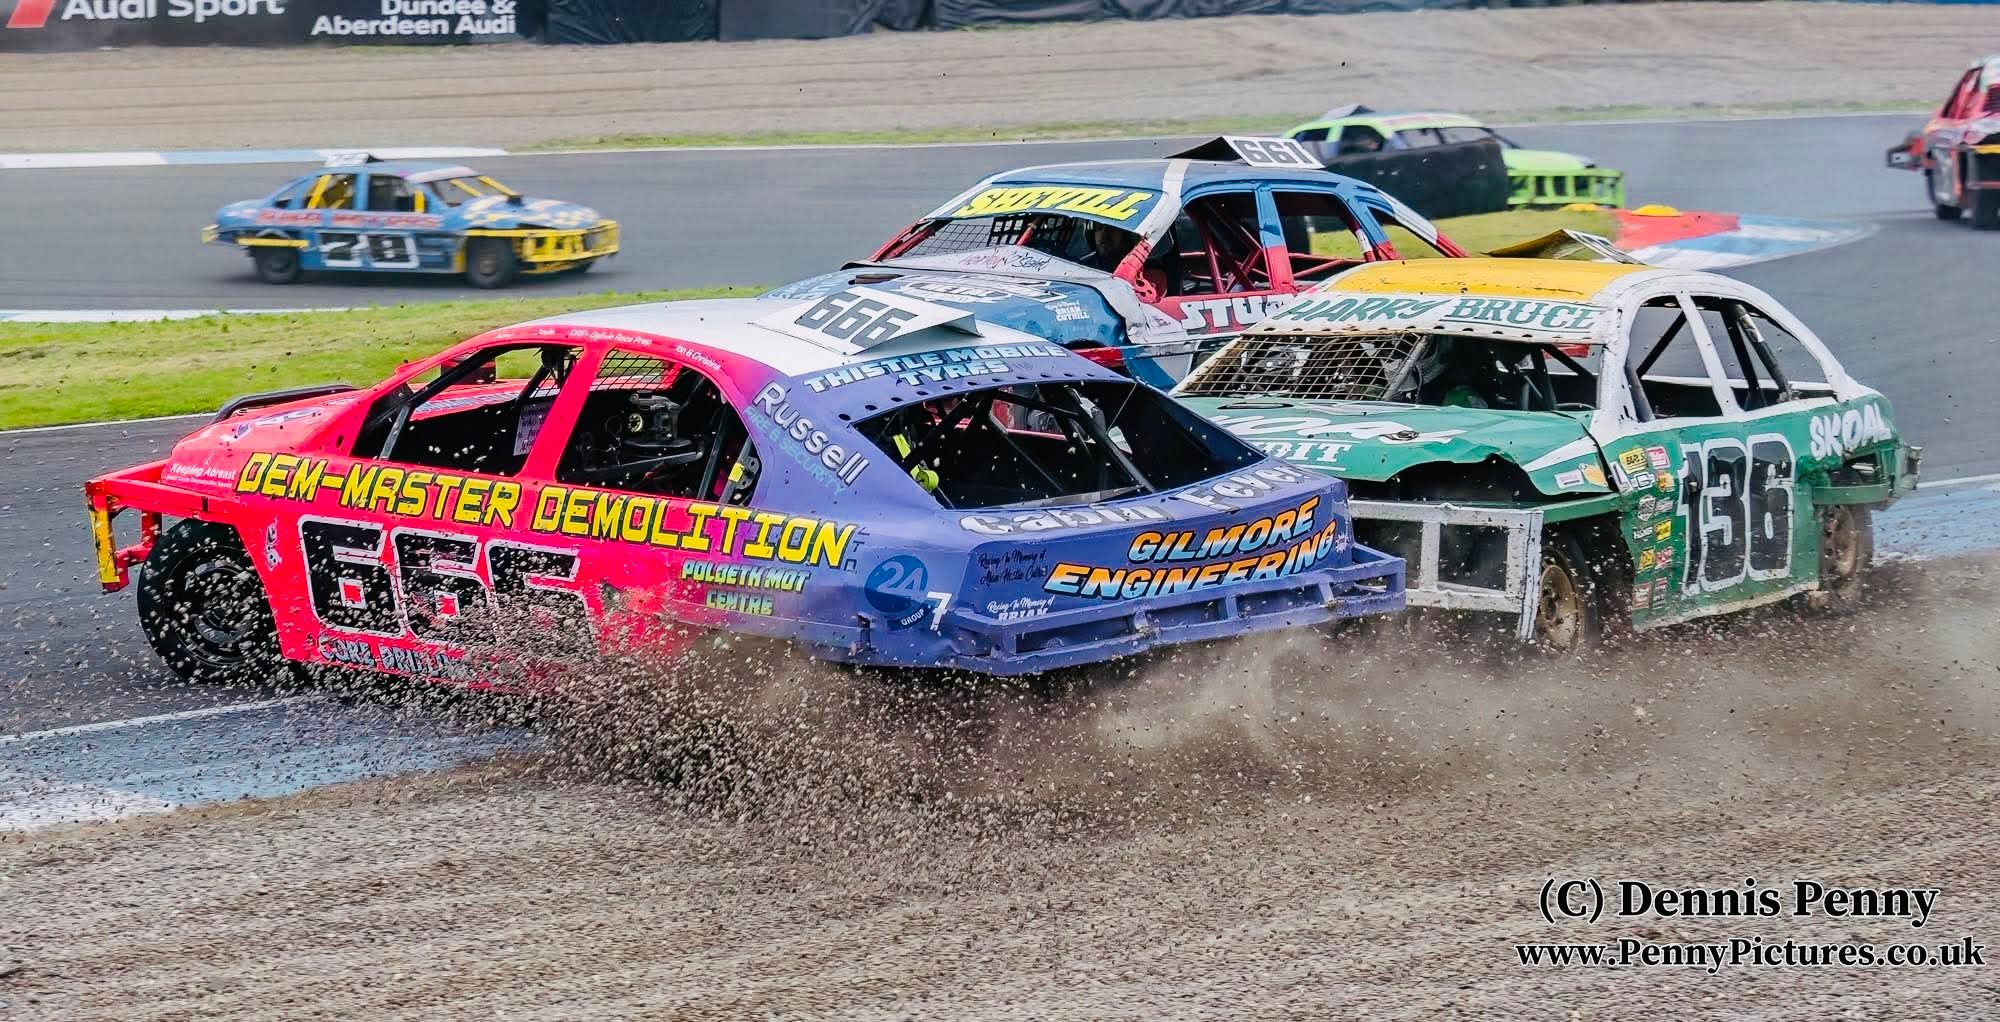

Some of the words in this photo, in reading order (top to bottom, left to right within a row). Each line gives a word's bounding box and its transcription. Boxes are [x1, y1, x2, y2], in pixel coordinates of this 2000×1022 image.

[167, 0, 286, 23] Sport
[381, 0, 487, 16] Dundee
[311, 16, 450, 36] Aberdeen
[454, 15, 517, 35] Audi
[1232, 140, 1314, 164] 661
[951, 186, 1153, 222] SHEVILL
[793, 290, 919, 348] 666
[1272, 297, 1452, 322] HARRY
[1447, 297, 1597, 329] BRUCE
[633, 336, 653, 346] Prep
[803, 350, 946, 394] THISTLE
[948, 343, 1068, 367] MOBILE
[899, 359, 1010, 387] TYRES
[751, 380, 870, 487] Russell
[1809, 402, 1893, 461] SKOAL
[169, 463, 204, 478] Keeping
[204, 467, 237, 481] Abreast
[779, 436, 847, 497] SECURITY
[236, 452, 522, 530] DEM-MASTER
[531, 485, 859, 569] DEMOLITION
[958, 503, 1175, 537] Cabin
[1171, 463, 1312, 513] Fever
[1676, 432, 1797, 600] 136
[1128, 496, 1321, 564] GILMORE
[1043, 519, 1337, 601] ENGINEERING
[764, 566, 812, 594] MOT
[876, 560, 924, 603] 24
[926, 590, 953, 631] 7
[705, 588, 776, 617] CENTRE
[900, 608, 925, 626] GROUP
[986, 600, 1009, 614] Racing
[1009, 599, 1020, 610] In
[1019, 596, 1046, 609] Memory
